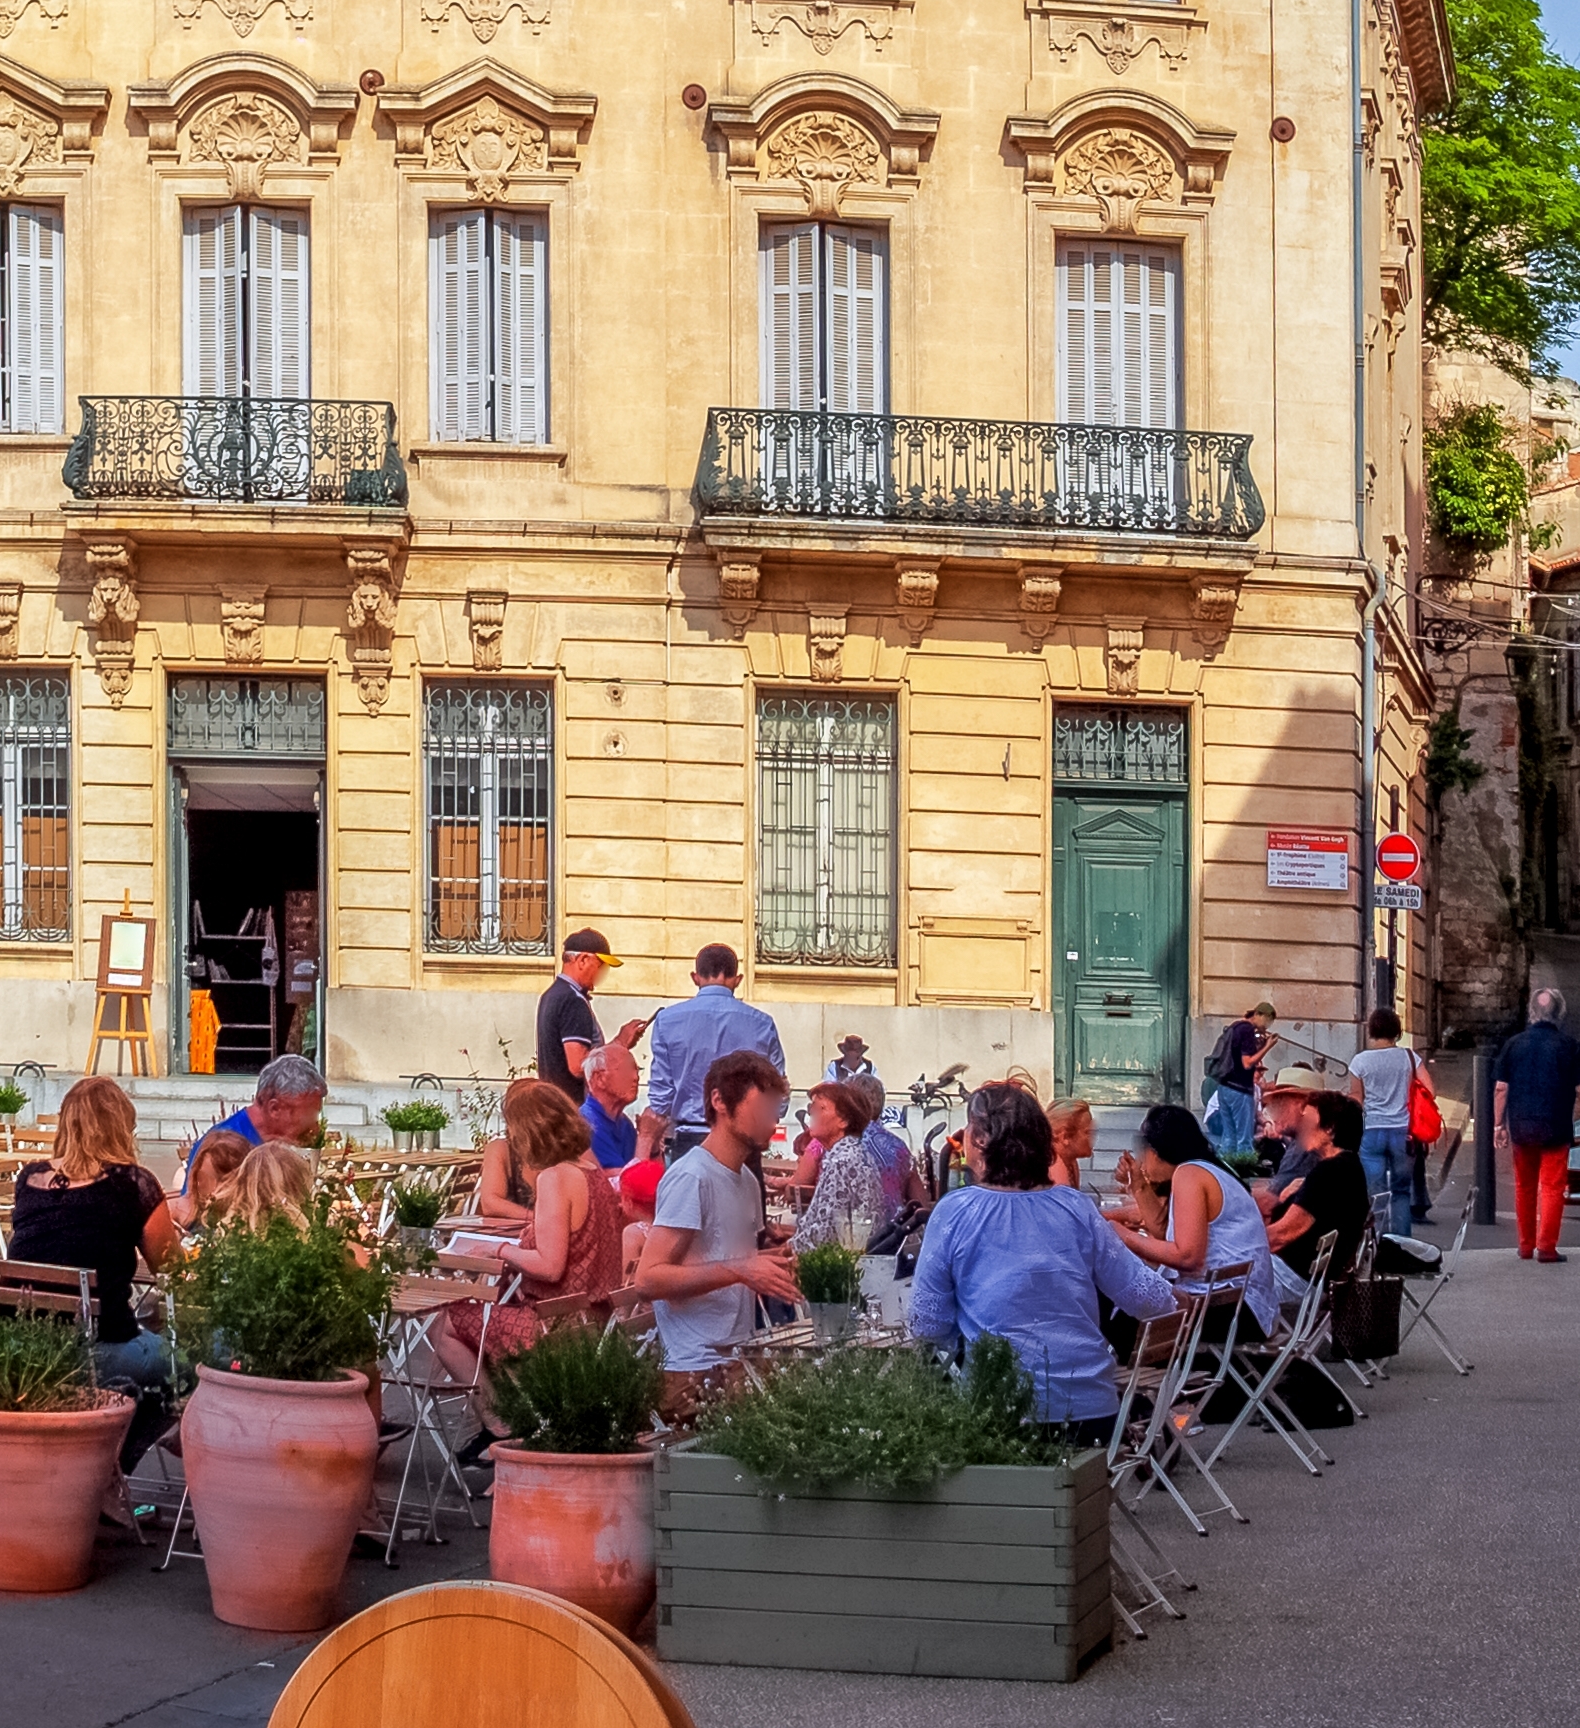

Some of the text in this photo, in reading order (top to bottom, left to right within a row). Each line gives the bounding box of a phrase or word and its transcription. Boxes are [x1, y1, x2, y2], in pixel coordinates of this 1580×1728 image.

[1385, 886, 1420, 898] SAMEDI
[1383, 896, 1398, 906] 06h
[1406, 898, 1419, 908] 15h
